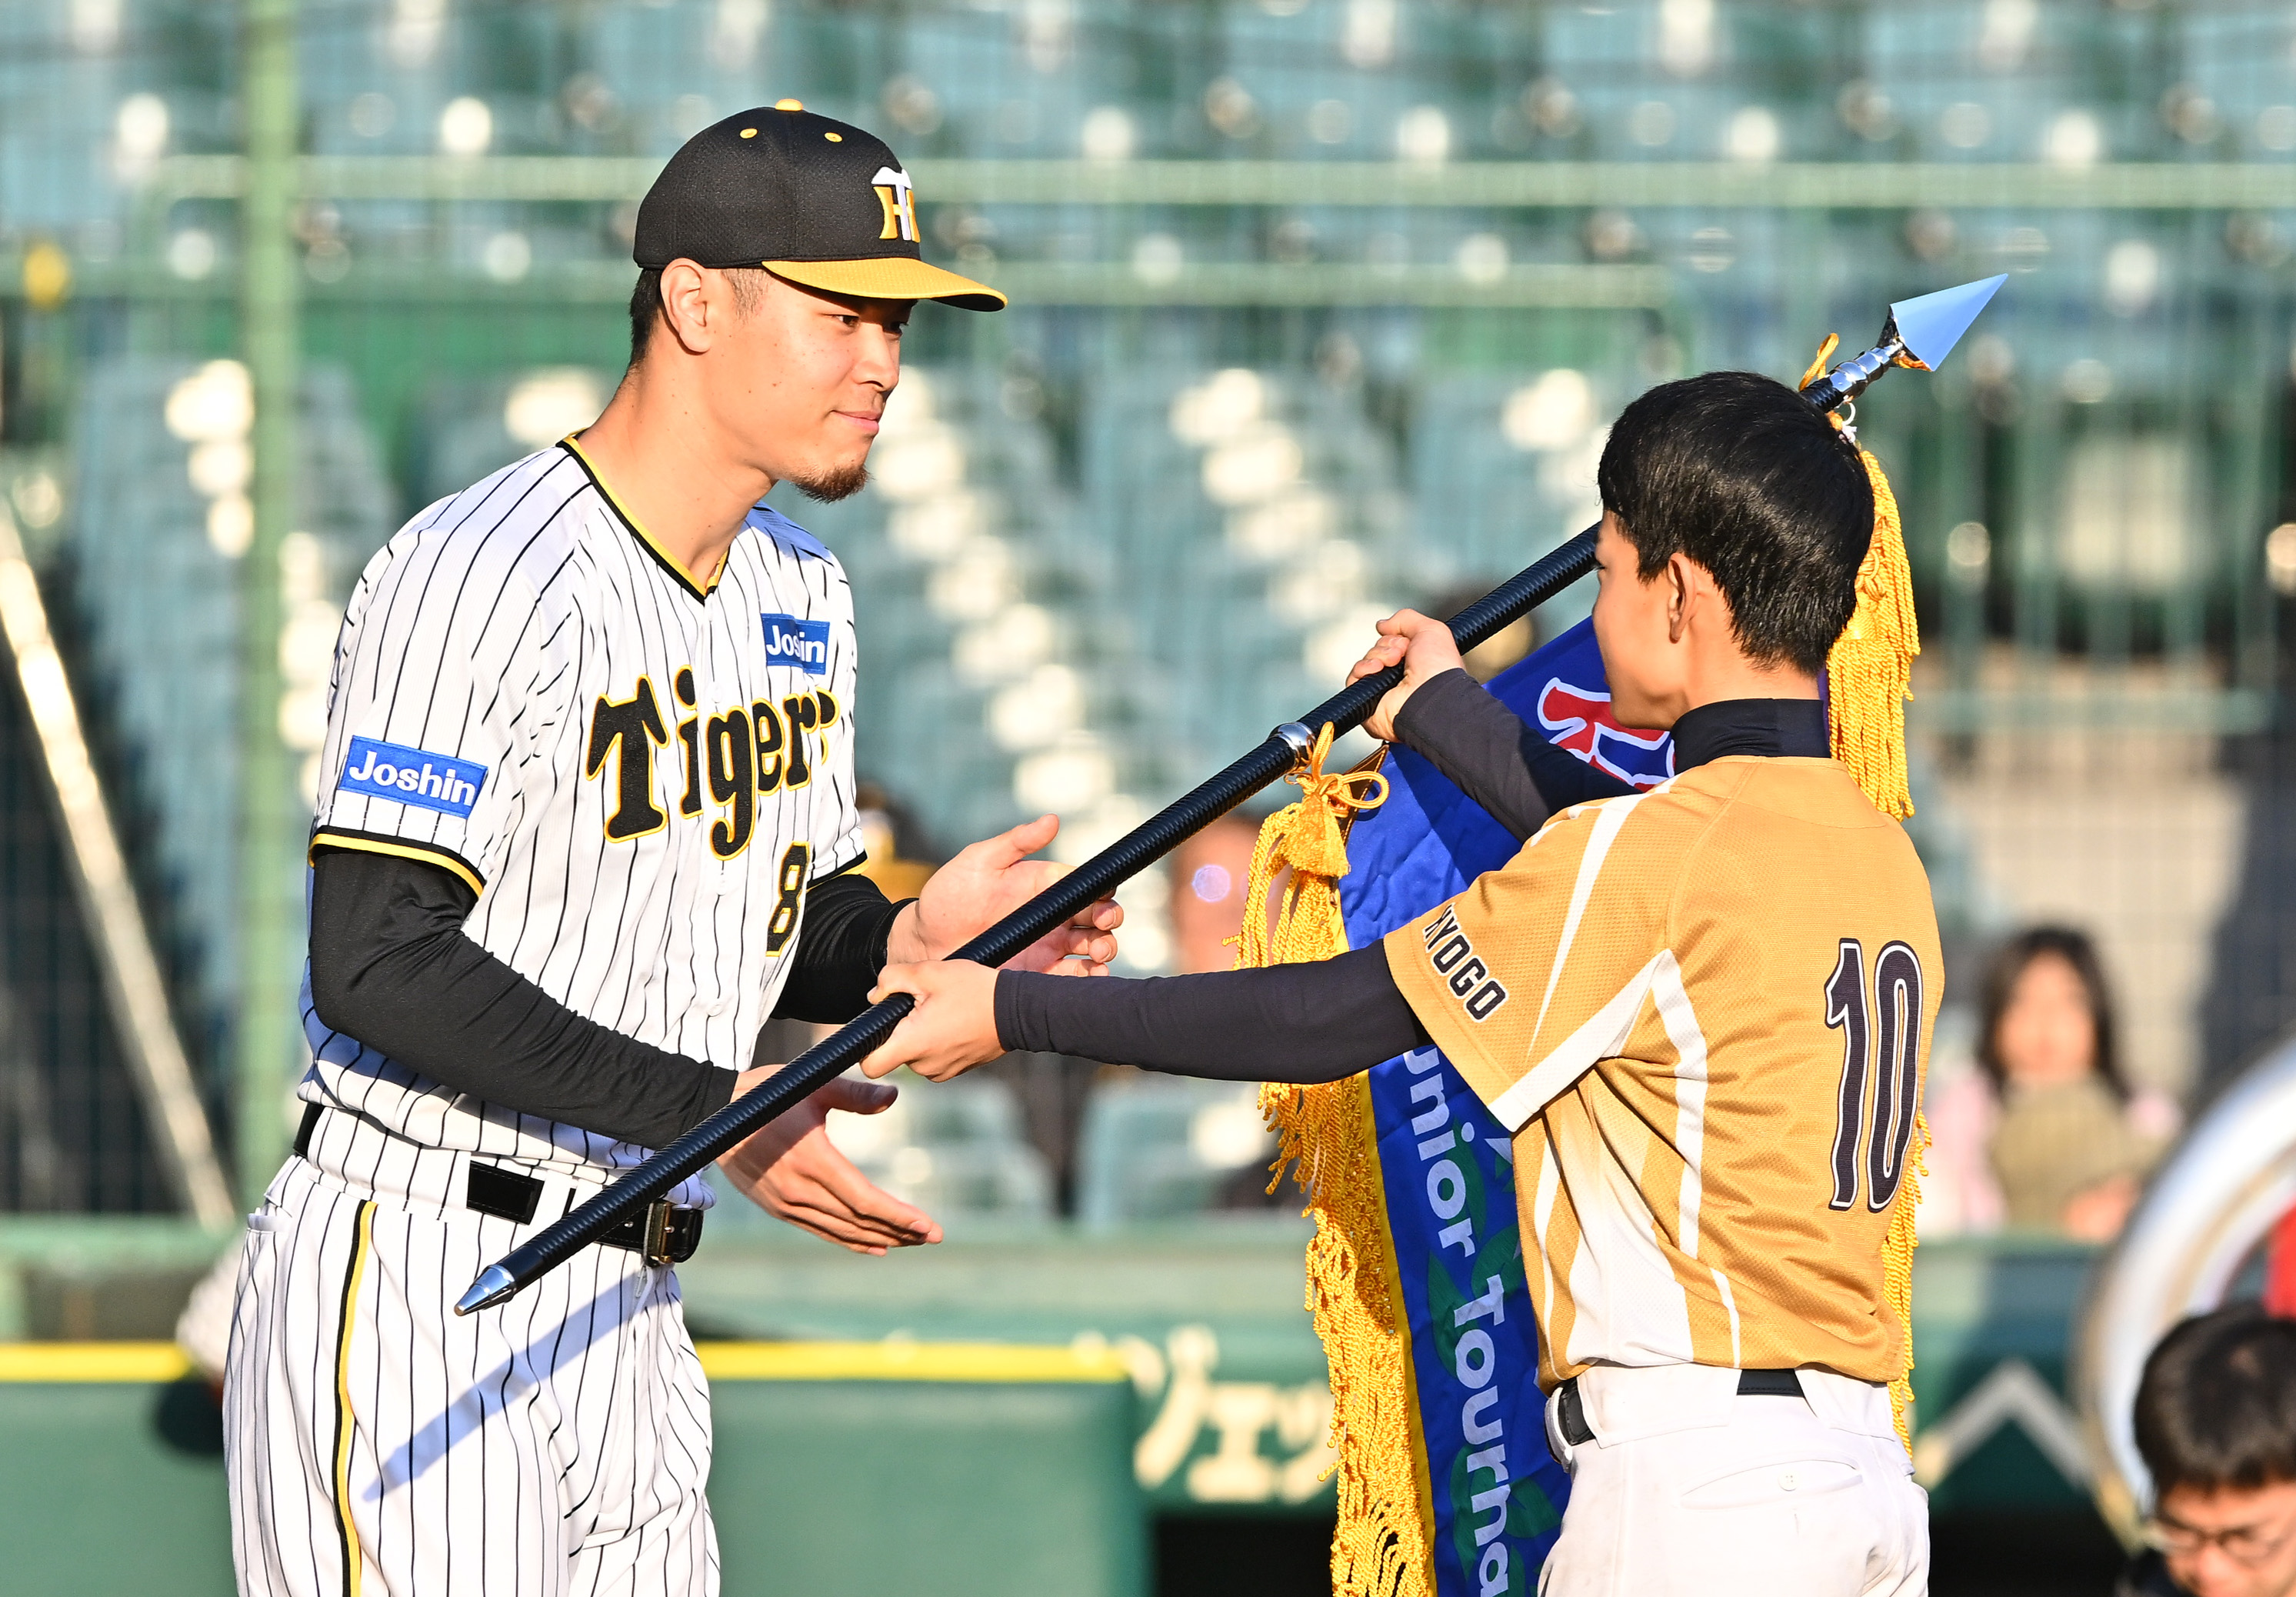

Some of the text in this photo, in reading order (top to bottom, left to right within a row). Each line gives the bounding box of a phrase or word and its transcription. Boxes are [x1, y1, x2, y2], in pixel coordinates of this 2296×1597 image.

[349, 751, 476, 807] Joshin
[1824, 938, 1923, 1213] 10
[1403, 1047, 1511, 1597] unior Tourna
